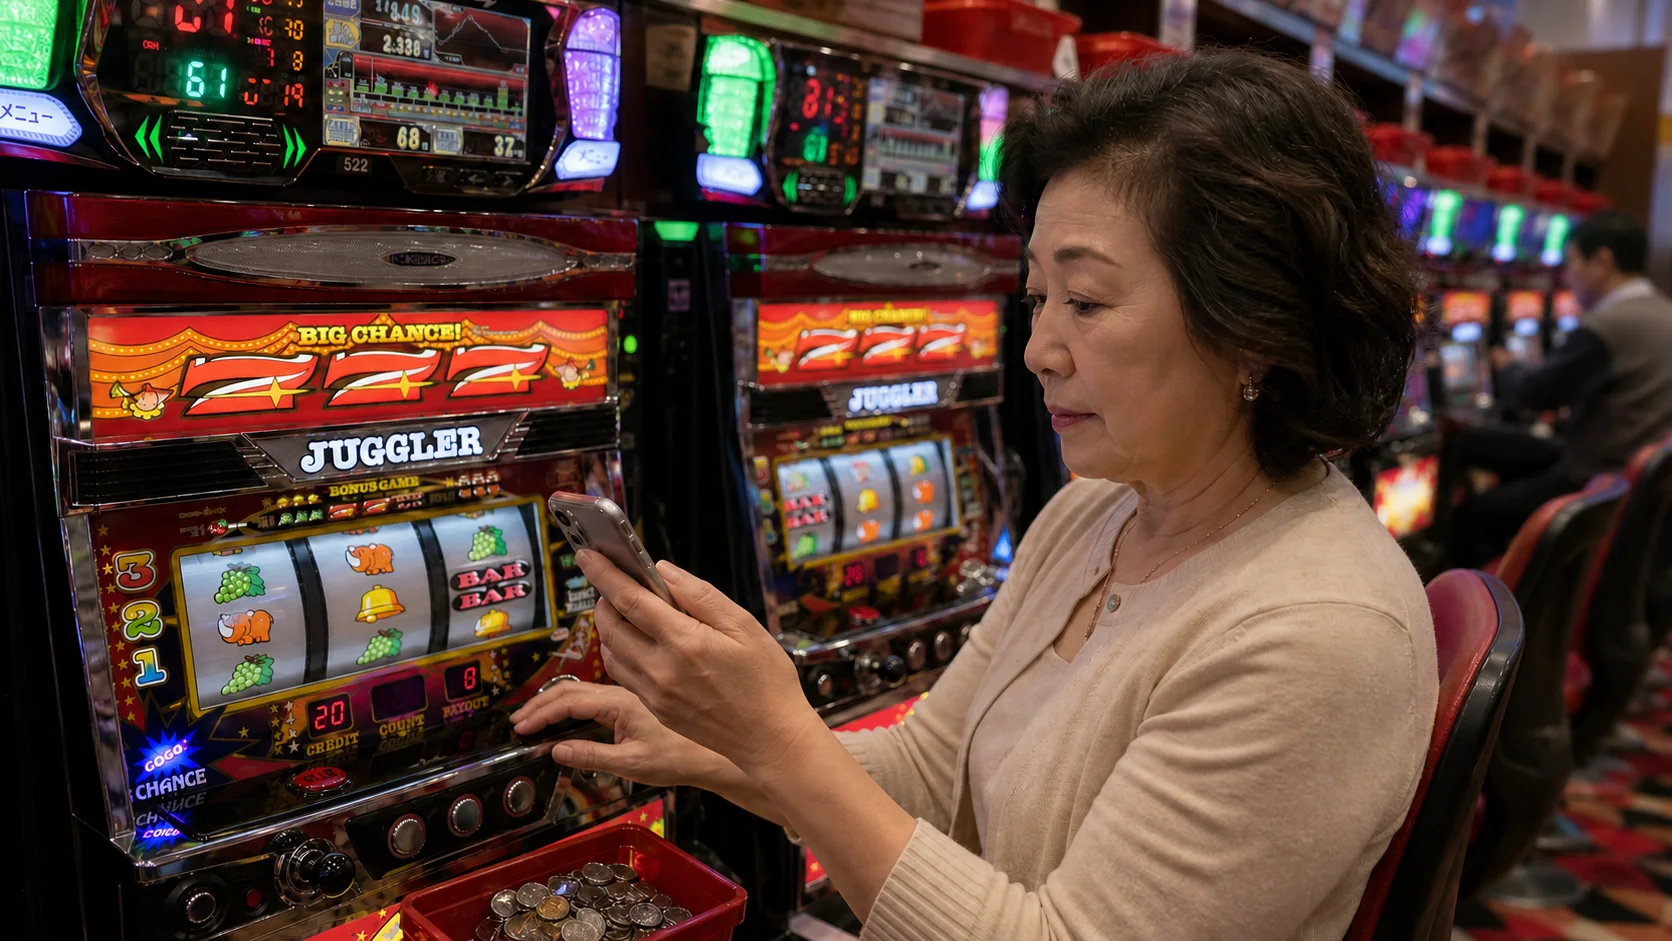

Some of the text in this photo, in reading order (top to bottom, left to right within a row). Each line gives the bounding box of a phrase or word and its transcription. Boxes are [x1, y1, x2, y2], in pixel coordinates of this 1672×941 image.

[186, 61, 227, 98] 61
[0, 103, 53, 123] メニュー
[397, 126, 420, 150] 68
[494, 135, 515, 157] 37
[344, 157, 369, 172] 522
[297, 326, 348, 345] BIG
[351, 322, 462, 344] CHANCE!
[300, 425, 484, 474] JUGGLER
[329, 476, 420, 498] BONUS GAME
[115, 550, 157, 591] 3
[458, 563, 526, 589] BAR
[460, 584, 527, 609] BAR
[121, 600, 163, 641] 2
[132, 647, 168, 686] 1
[314, 700, 345, 731] 20
[442, 696, 489, 719] PAYOUT
[379, 714, 424, 737] COUNT
[306, 731, 360, 757] CREDIT
[135, 768, 207, 800] CHANCE
